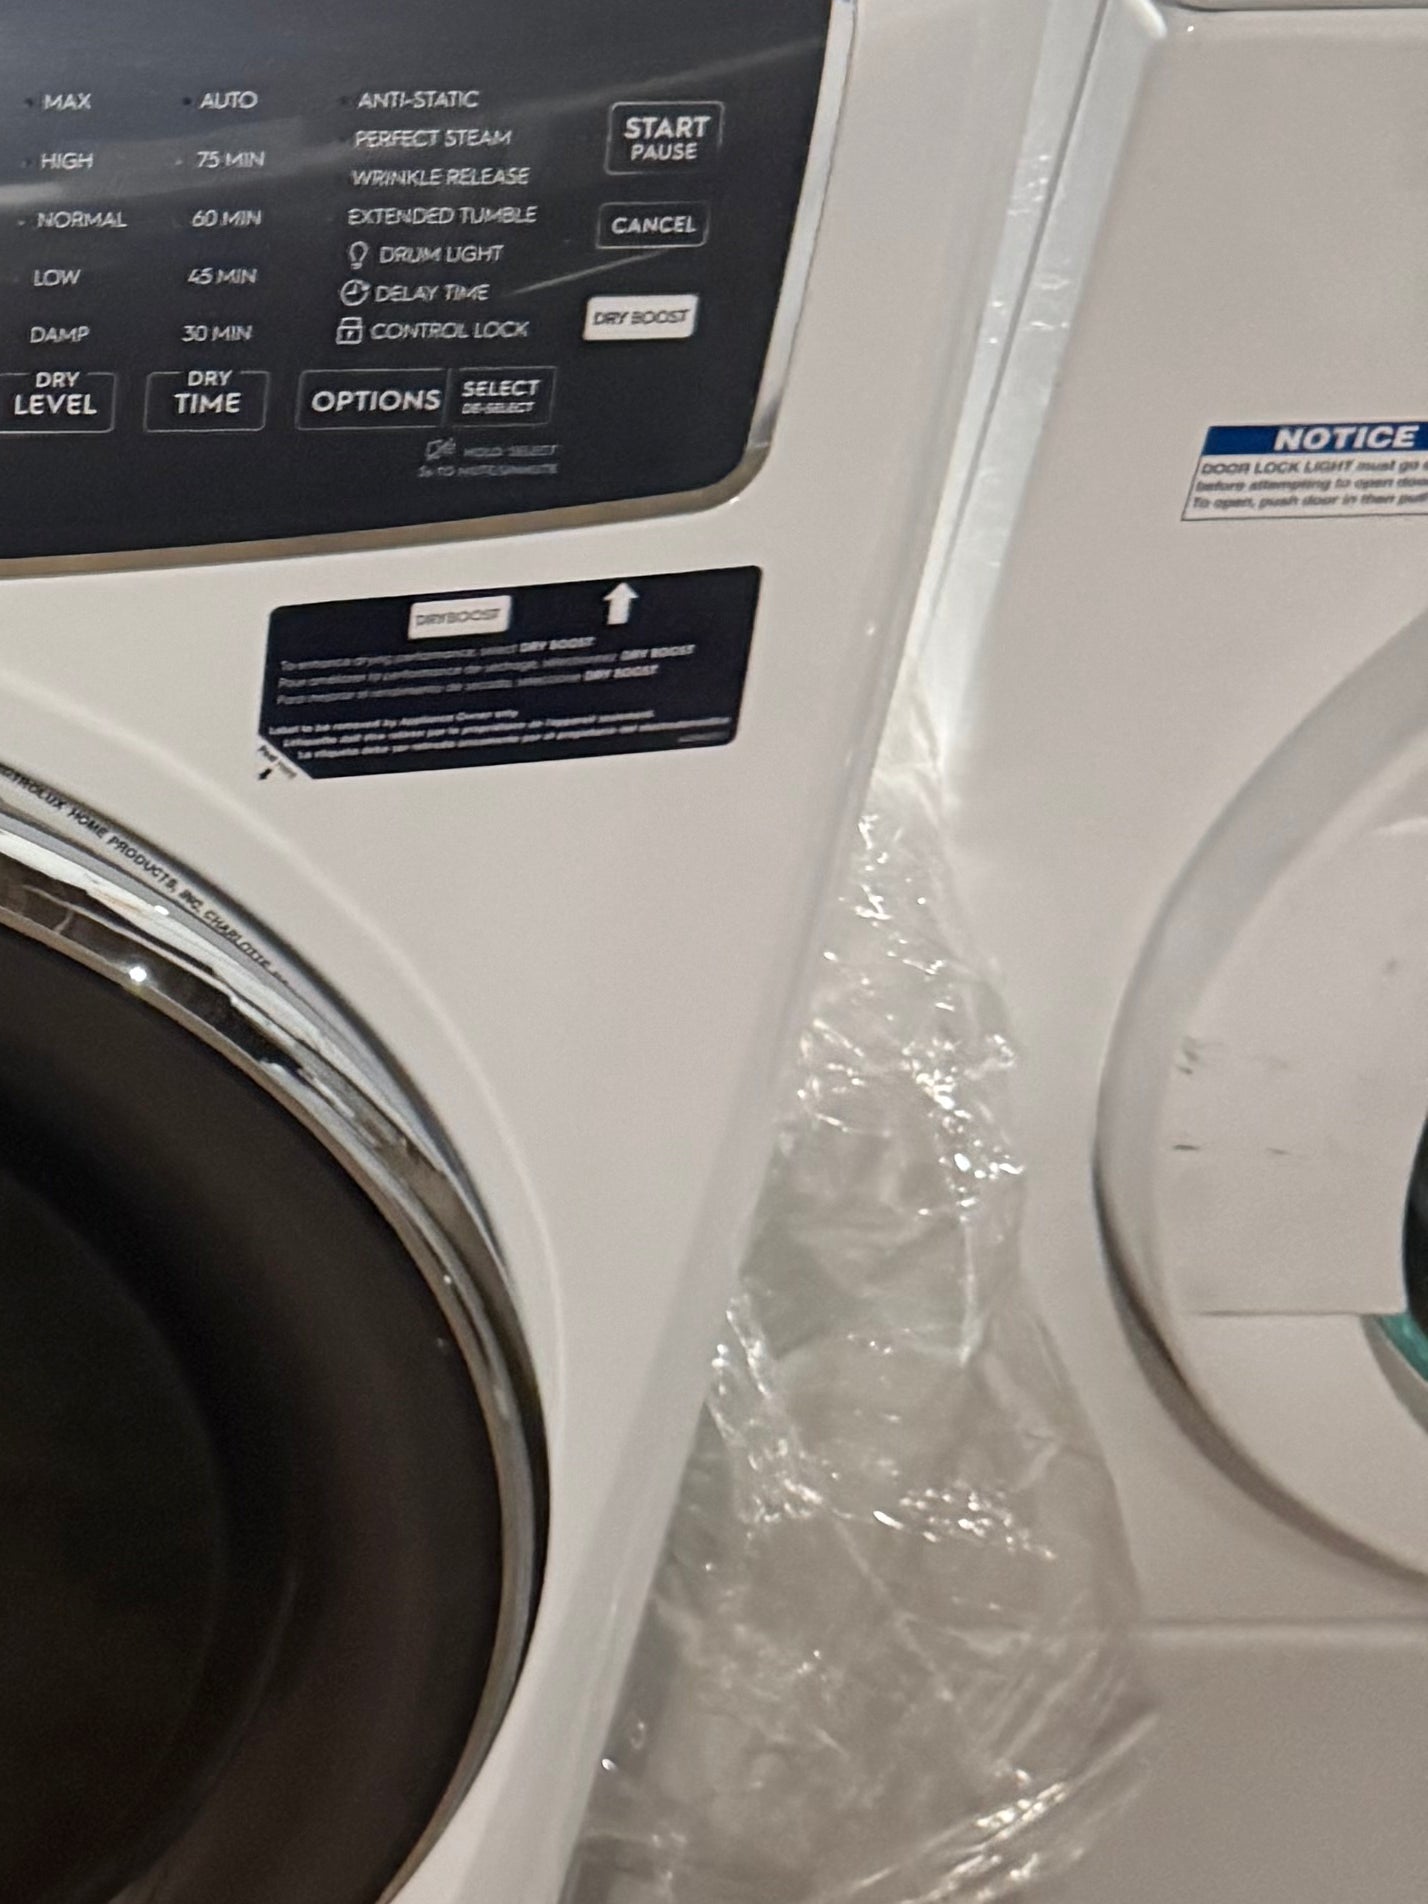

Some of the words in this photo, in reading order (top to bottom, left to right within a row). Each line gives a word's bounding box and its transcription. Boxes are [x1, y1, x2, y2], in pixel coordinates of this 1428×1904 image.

[44, 94, 91, 111] MAX
[200, 92, 257, 109] AUTO
[358, 91, 479, 109] ANTI-STATIC
[624, 116, 711, 140] START
[355, 129, 440, 147] PERFECT
[444, 129, 511, 146] STEAM
[197, 151, 220, 168] 75
[226, 151, 265, 168] MIN
[631, 143, 697, 161] PAUSE
[41, 153, 93, 170] HIGH
[352, 168, 443, 186] WRINKLE
[447, 168, 530, 185] RELEASE
[37, 212, 127, 229] NORMAL
[191, 210, 215, 227] 60
[221, 210, 261, 226] MIN
[348, 207, 454, 225] EXTENDED
[459, 206, 537, 224] TUMBLE
[612, 215, 697, 235] CANCEL
[379, 246, 441, 263] DRUM
[447, 245, 504, 262] LIGHT
[34, 270, 81, 286] LOW
[187, 268, 213, 285] 45
[218, 268, 257, 284] MIN
[374, 285, 438, 302] DELAY
[444, 284, 489, 301] TIME
[593, 310, 629, 326] DRY
[631, 308, 688, 325] BOOST
[30, 326, 89, 344] DAMP
[182, 325, 208, 342] 30
[213, 325, 253, 342] MIN
[371, 322, 468, 340] CONTROL
[473, 322, 529, 339] LOCK
[36, 372, 79, 388] DRY
[187, 370, 232, 386] DRY
[463, 380, 541, 398] SELECT
[14, 395, 97, 415] LEVEL
[174, 393, 241, 414] TIME
[312, 390, 441, 412] OPTIONS
[1273, 425, 1419, 452] NOTICE
[1202, 462, 1250, 475] DOOR
[1254, 462, 1299, 474] LOCK
[1304, 460, 1353, 473] LIGHT
[1249, 479, 1330, 492] attempting
[1335, 479, 1352, 488] to
[1355, 479, 1394, 489] open
[1194, 497, 1209, 508] To
[1259, 495, 1298, 508] push
[1302, 495, 1340, 506] door
[68, 807, 109, 840] HOME
[107, 835, 177, 893] PRODUCTS,
